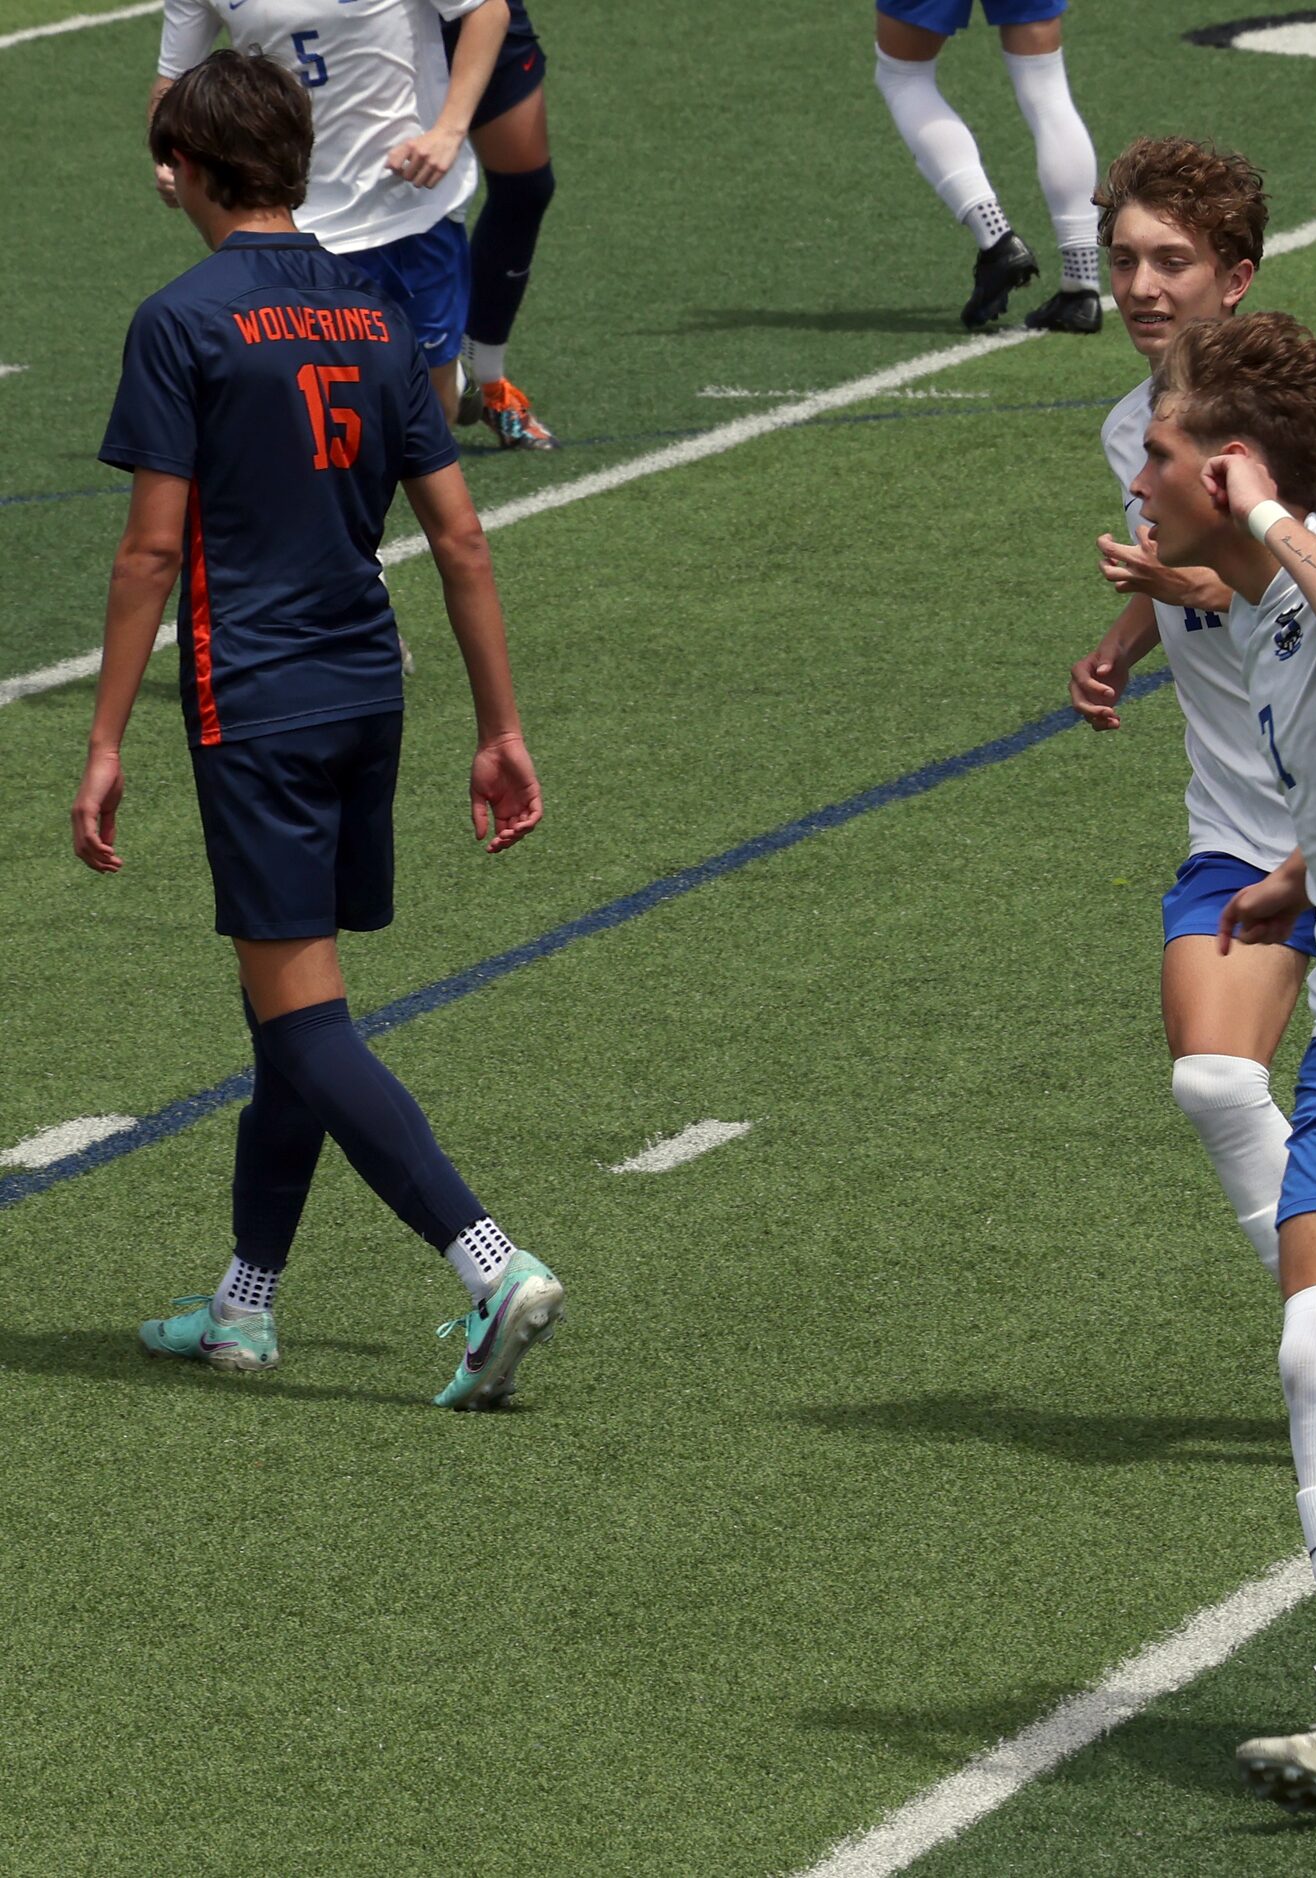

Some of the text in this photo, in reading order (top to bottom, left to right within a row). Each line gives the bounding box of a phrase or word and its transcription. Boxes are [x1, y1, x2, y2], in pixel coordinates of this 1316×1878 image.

[291, 30, 328, 87] 5
[233, 306, 390, 344] WOLVERINES
[296, 364, 361, 470] 15
[1258, 704, 1296, 789] 7
